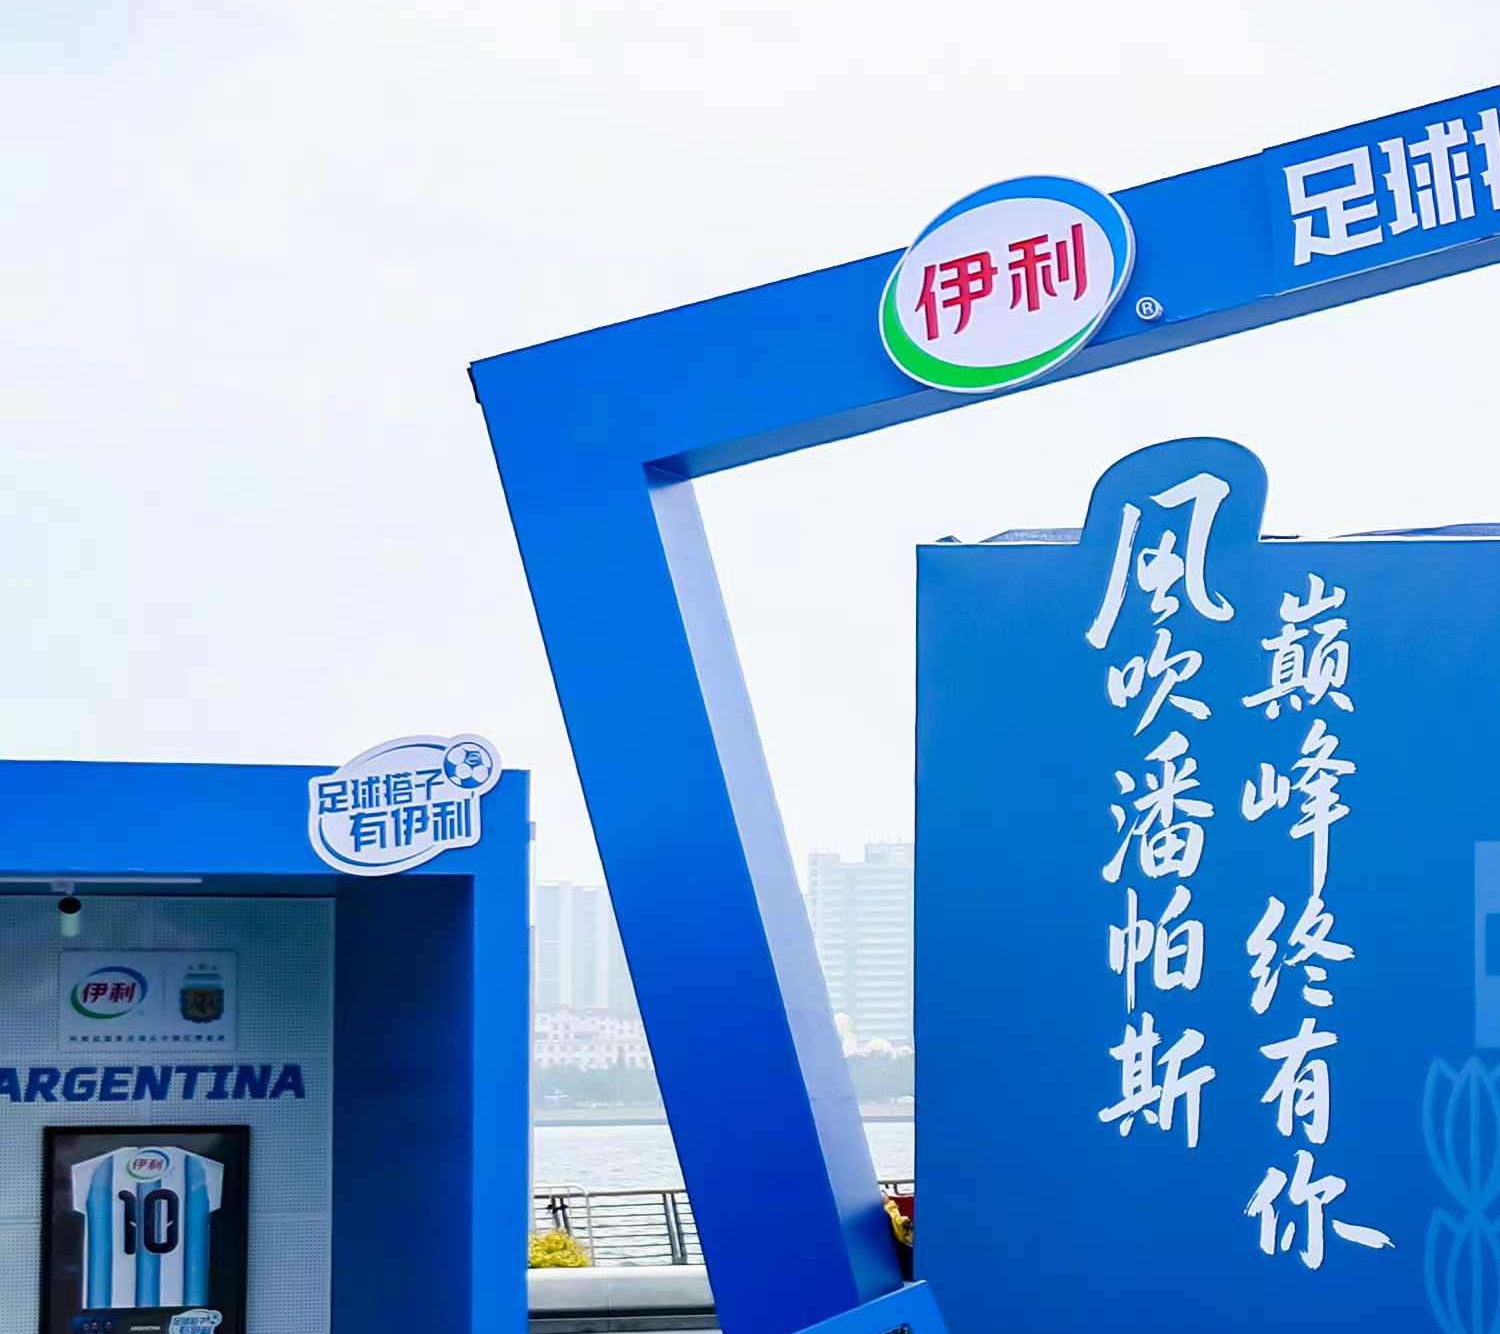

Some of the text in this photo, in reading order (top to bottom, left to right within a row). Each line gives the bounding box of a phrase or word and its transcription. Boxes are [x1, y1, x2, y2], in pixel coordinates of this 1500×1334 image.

[914, 221, 1089, 342] 伊利
[318, 768, 444, 815] 足球搭子
[349, 798, 472, 853] 有伊利
[82, 982, 136, 1004] 伊利
[0, 1065, 306, 1103] ARGENTINA
[118, 1189, 178, 1255] 10
